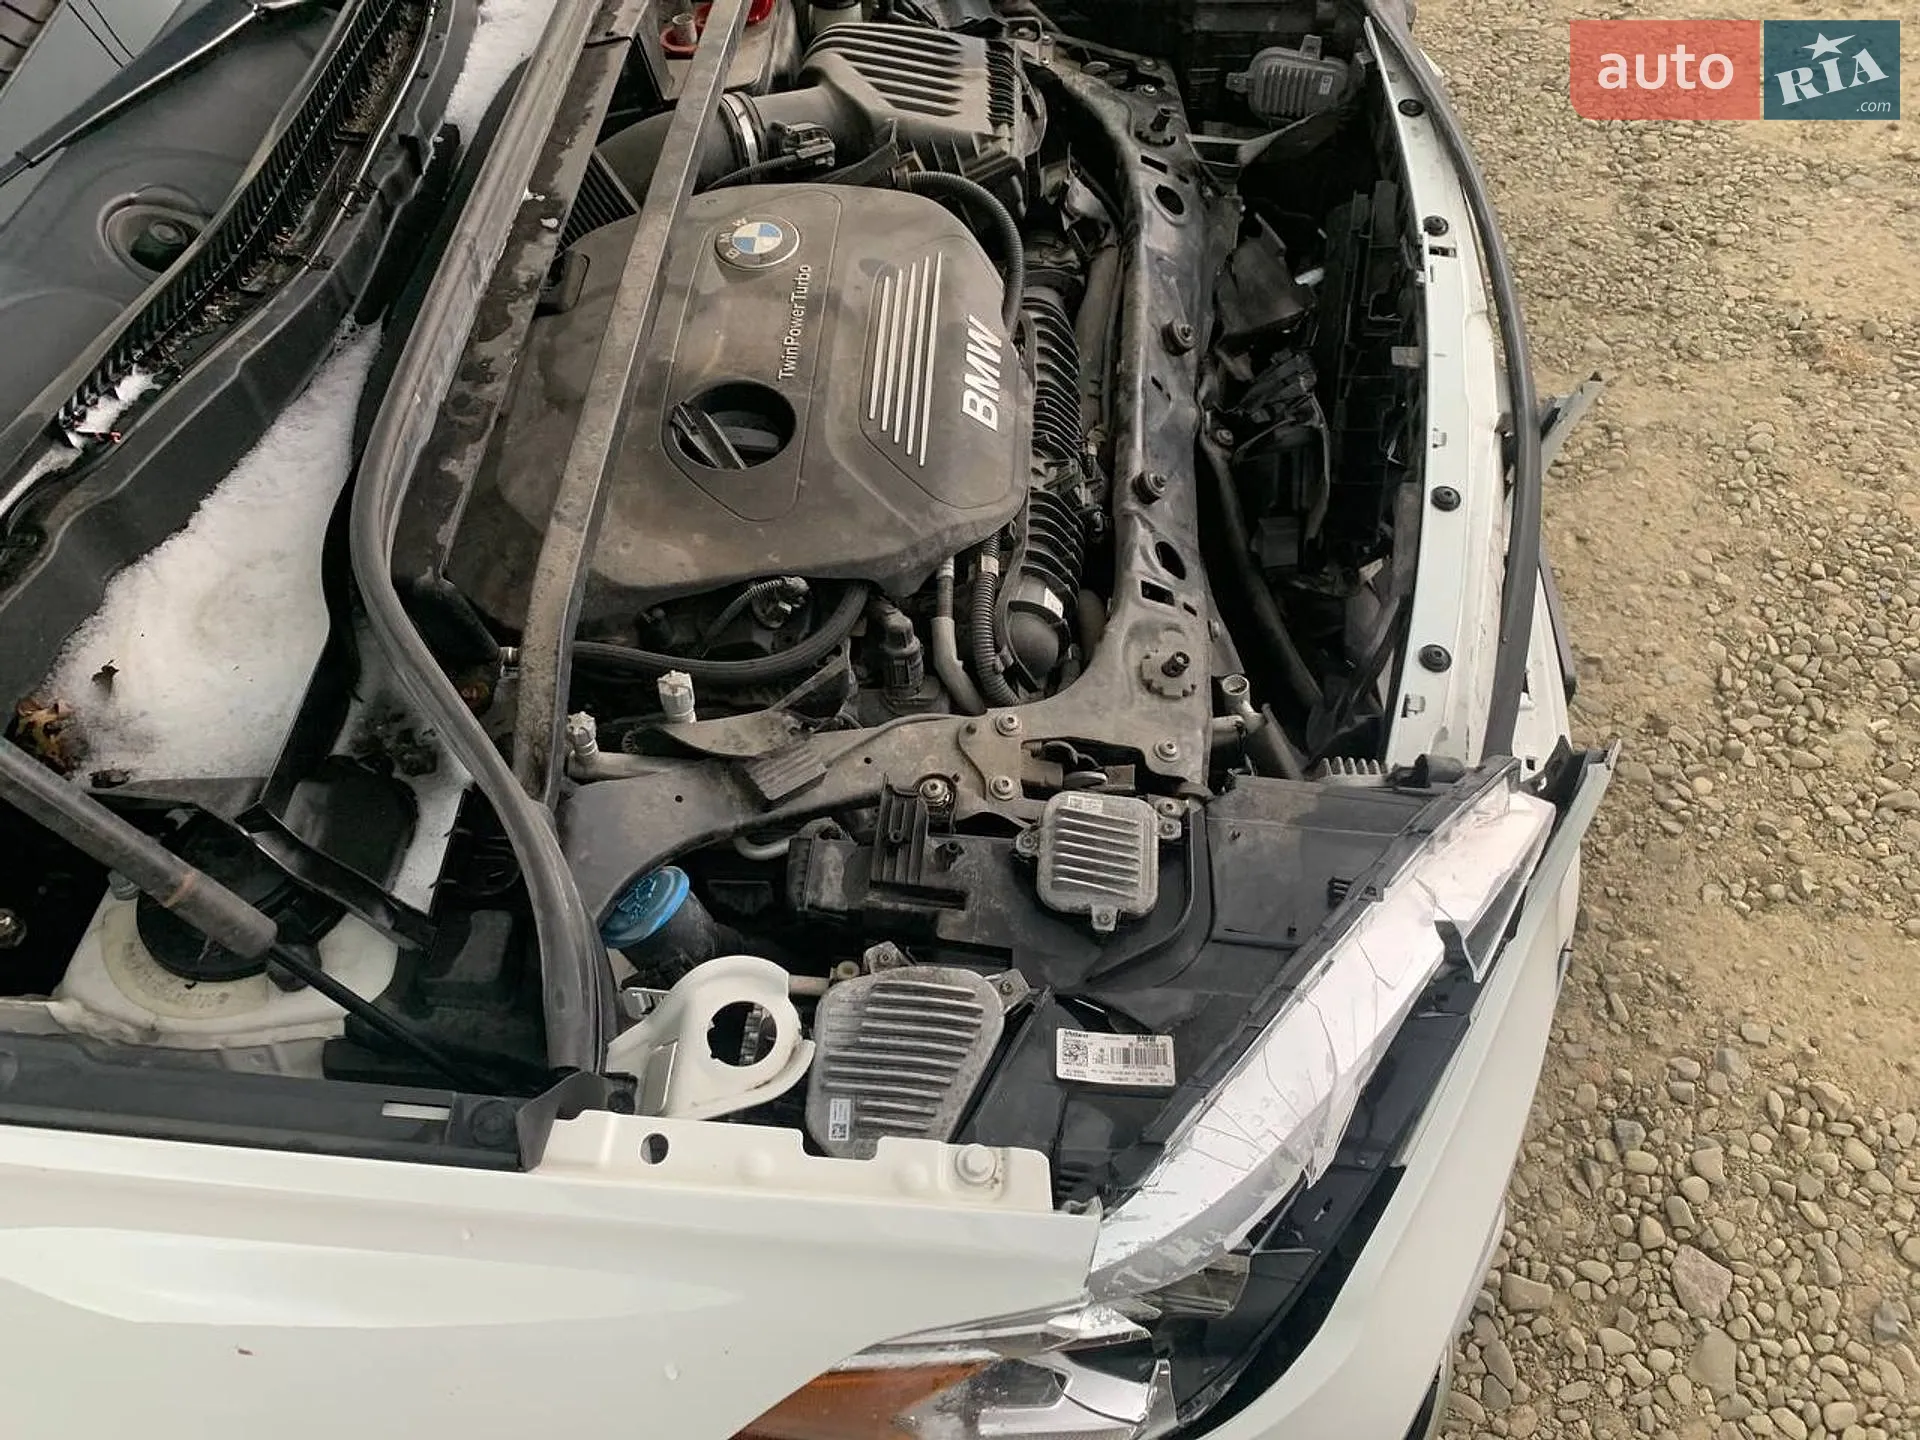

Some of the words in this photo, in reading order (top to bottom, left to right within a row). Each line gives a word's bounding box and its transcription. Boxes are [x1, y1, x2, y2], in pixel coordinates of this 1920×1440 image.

[720, 217, 747, 260] BMW
[790, 264, 812, 304] Turbo
[778, 303, 806, 382] TwinPower
[962, 314, 1002, 432] BMW
